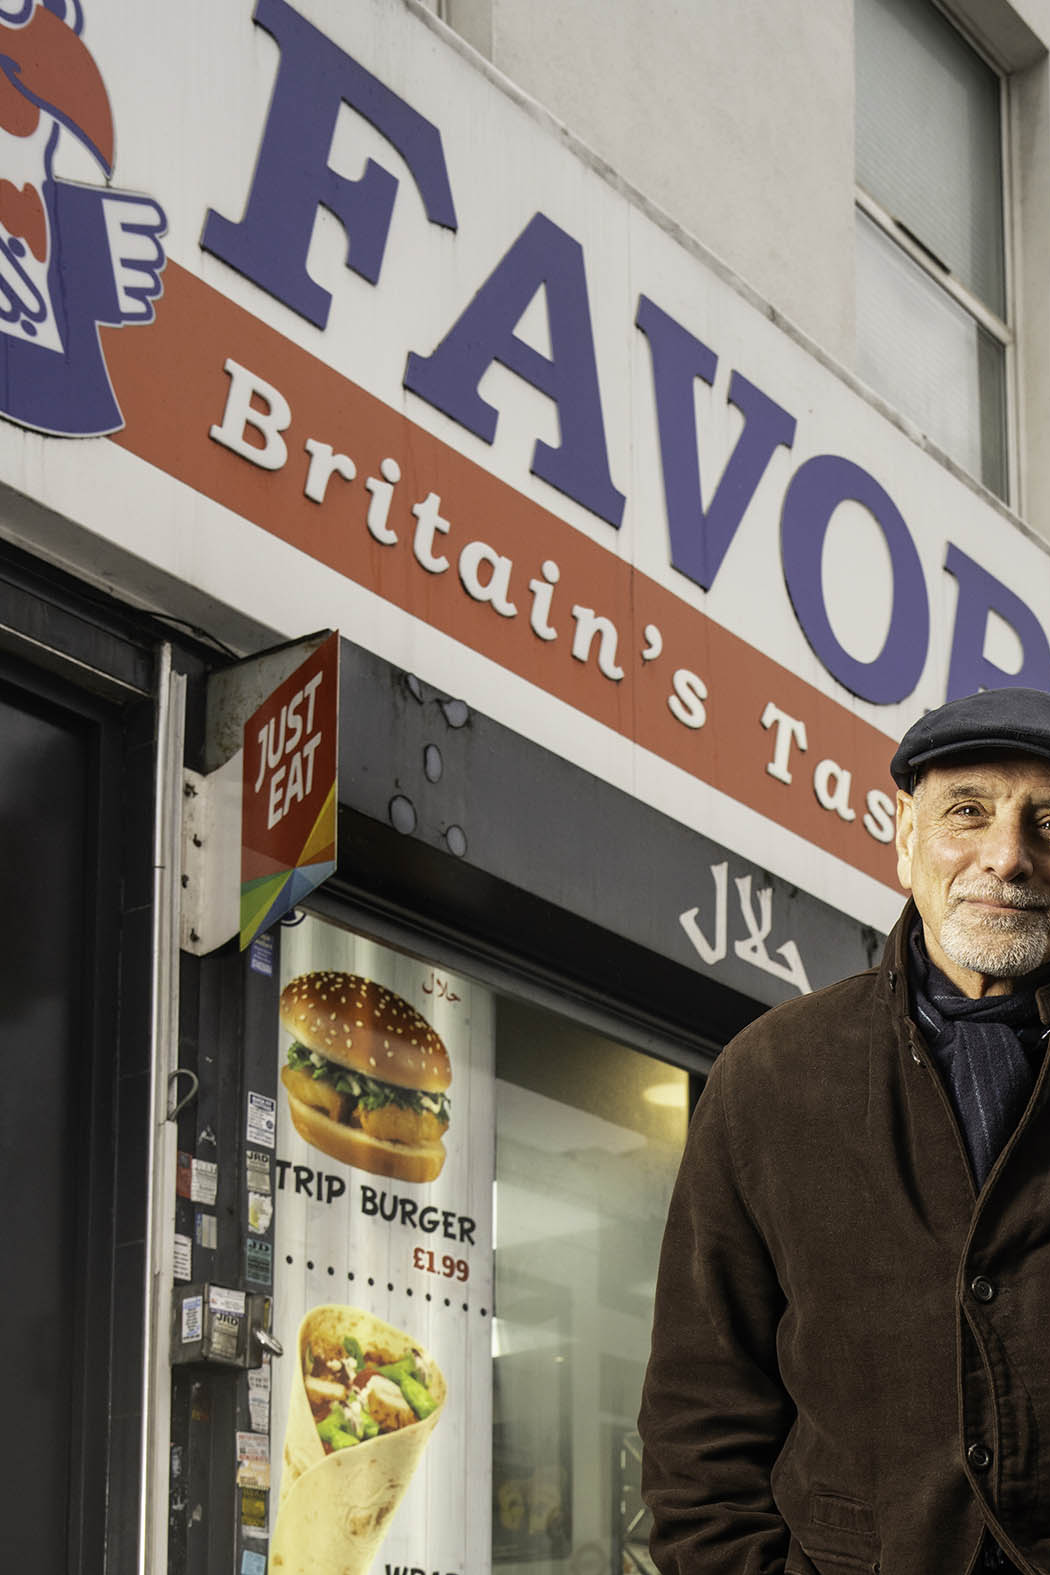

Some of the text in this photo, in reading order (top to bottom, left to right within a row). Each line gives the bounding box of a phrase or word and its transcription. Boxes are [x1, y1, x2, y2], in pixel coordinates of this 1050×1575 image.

[209, 357, 709, 730] Britain's
[255, 670, 323, 793] JUST
[267, 731, 322, 830] EAT
[361, 1185, 476, 1246] BURGER
[413, 1247, 470, 1283] £1.99
